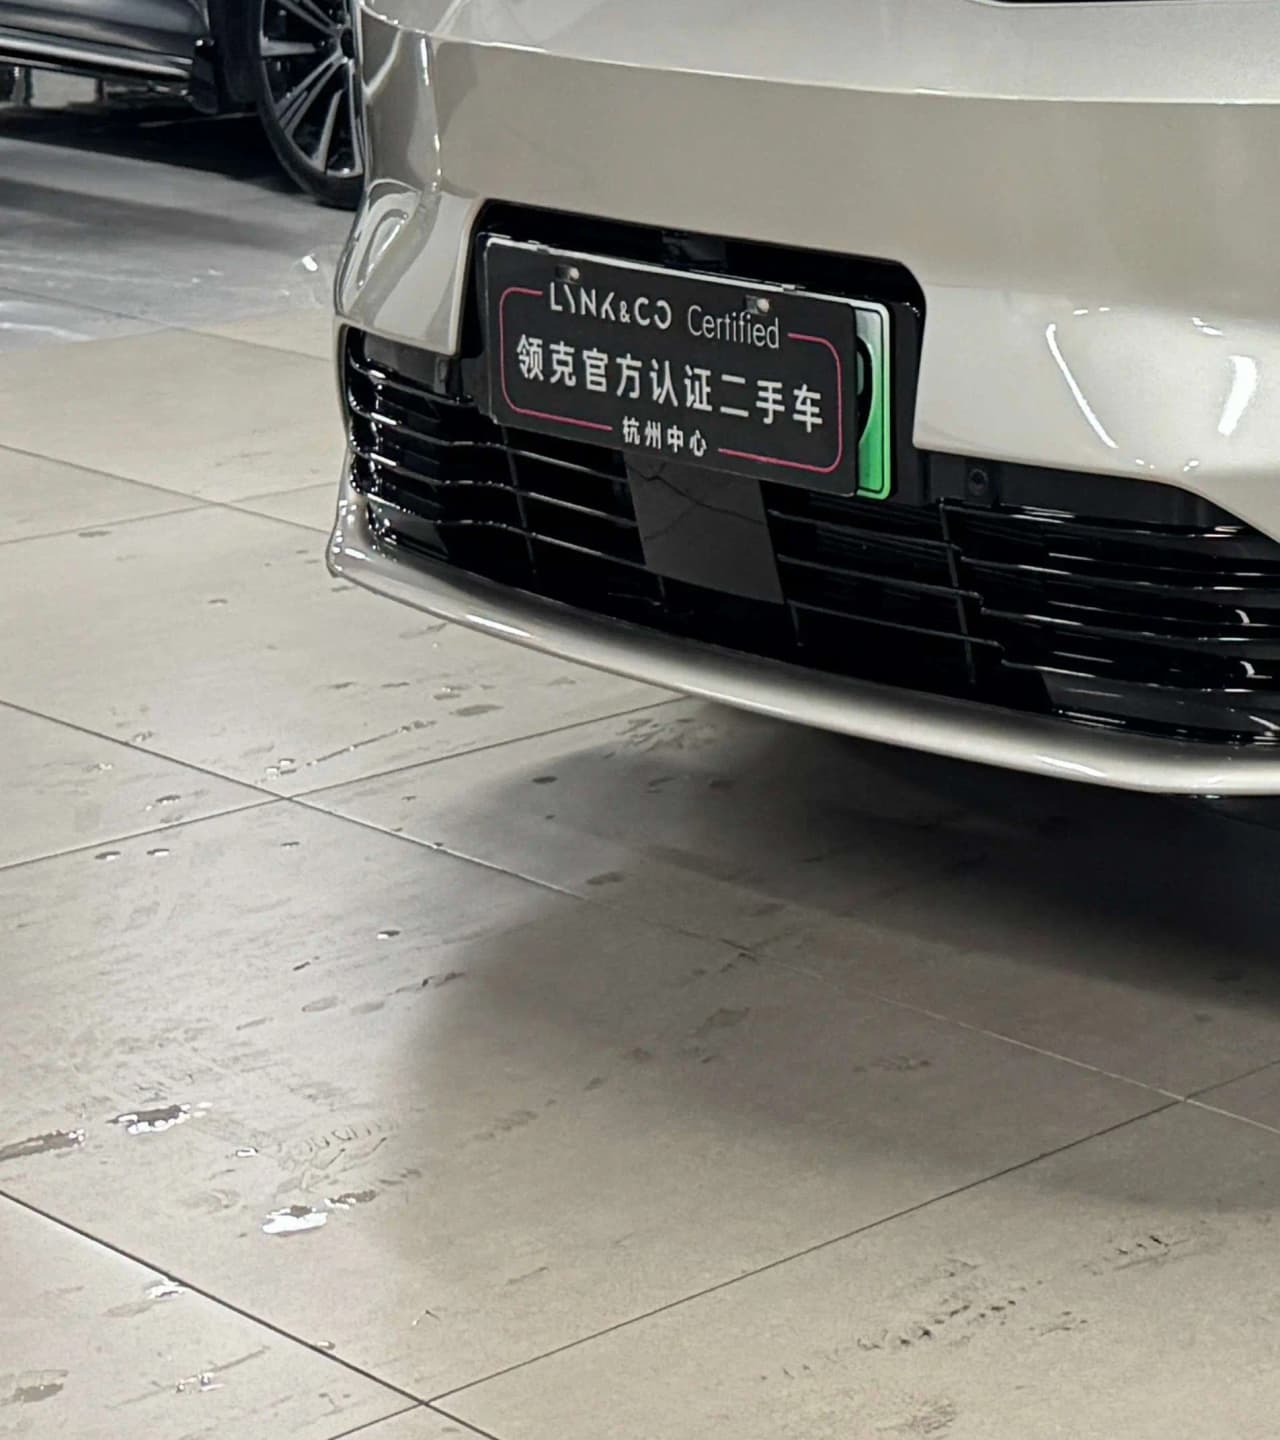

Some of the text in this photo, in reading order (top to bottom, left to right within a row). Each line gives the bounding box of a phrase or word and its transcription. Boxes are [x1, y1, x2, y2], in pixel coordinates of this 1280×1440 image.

[687, 304, 780, 349] Certified
[516, 333, 823, 433] 领克官方认证二手车
[622, 416, 708, 457] 杭州中心
